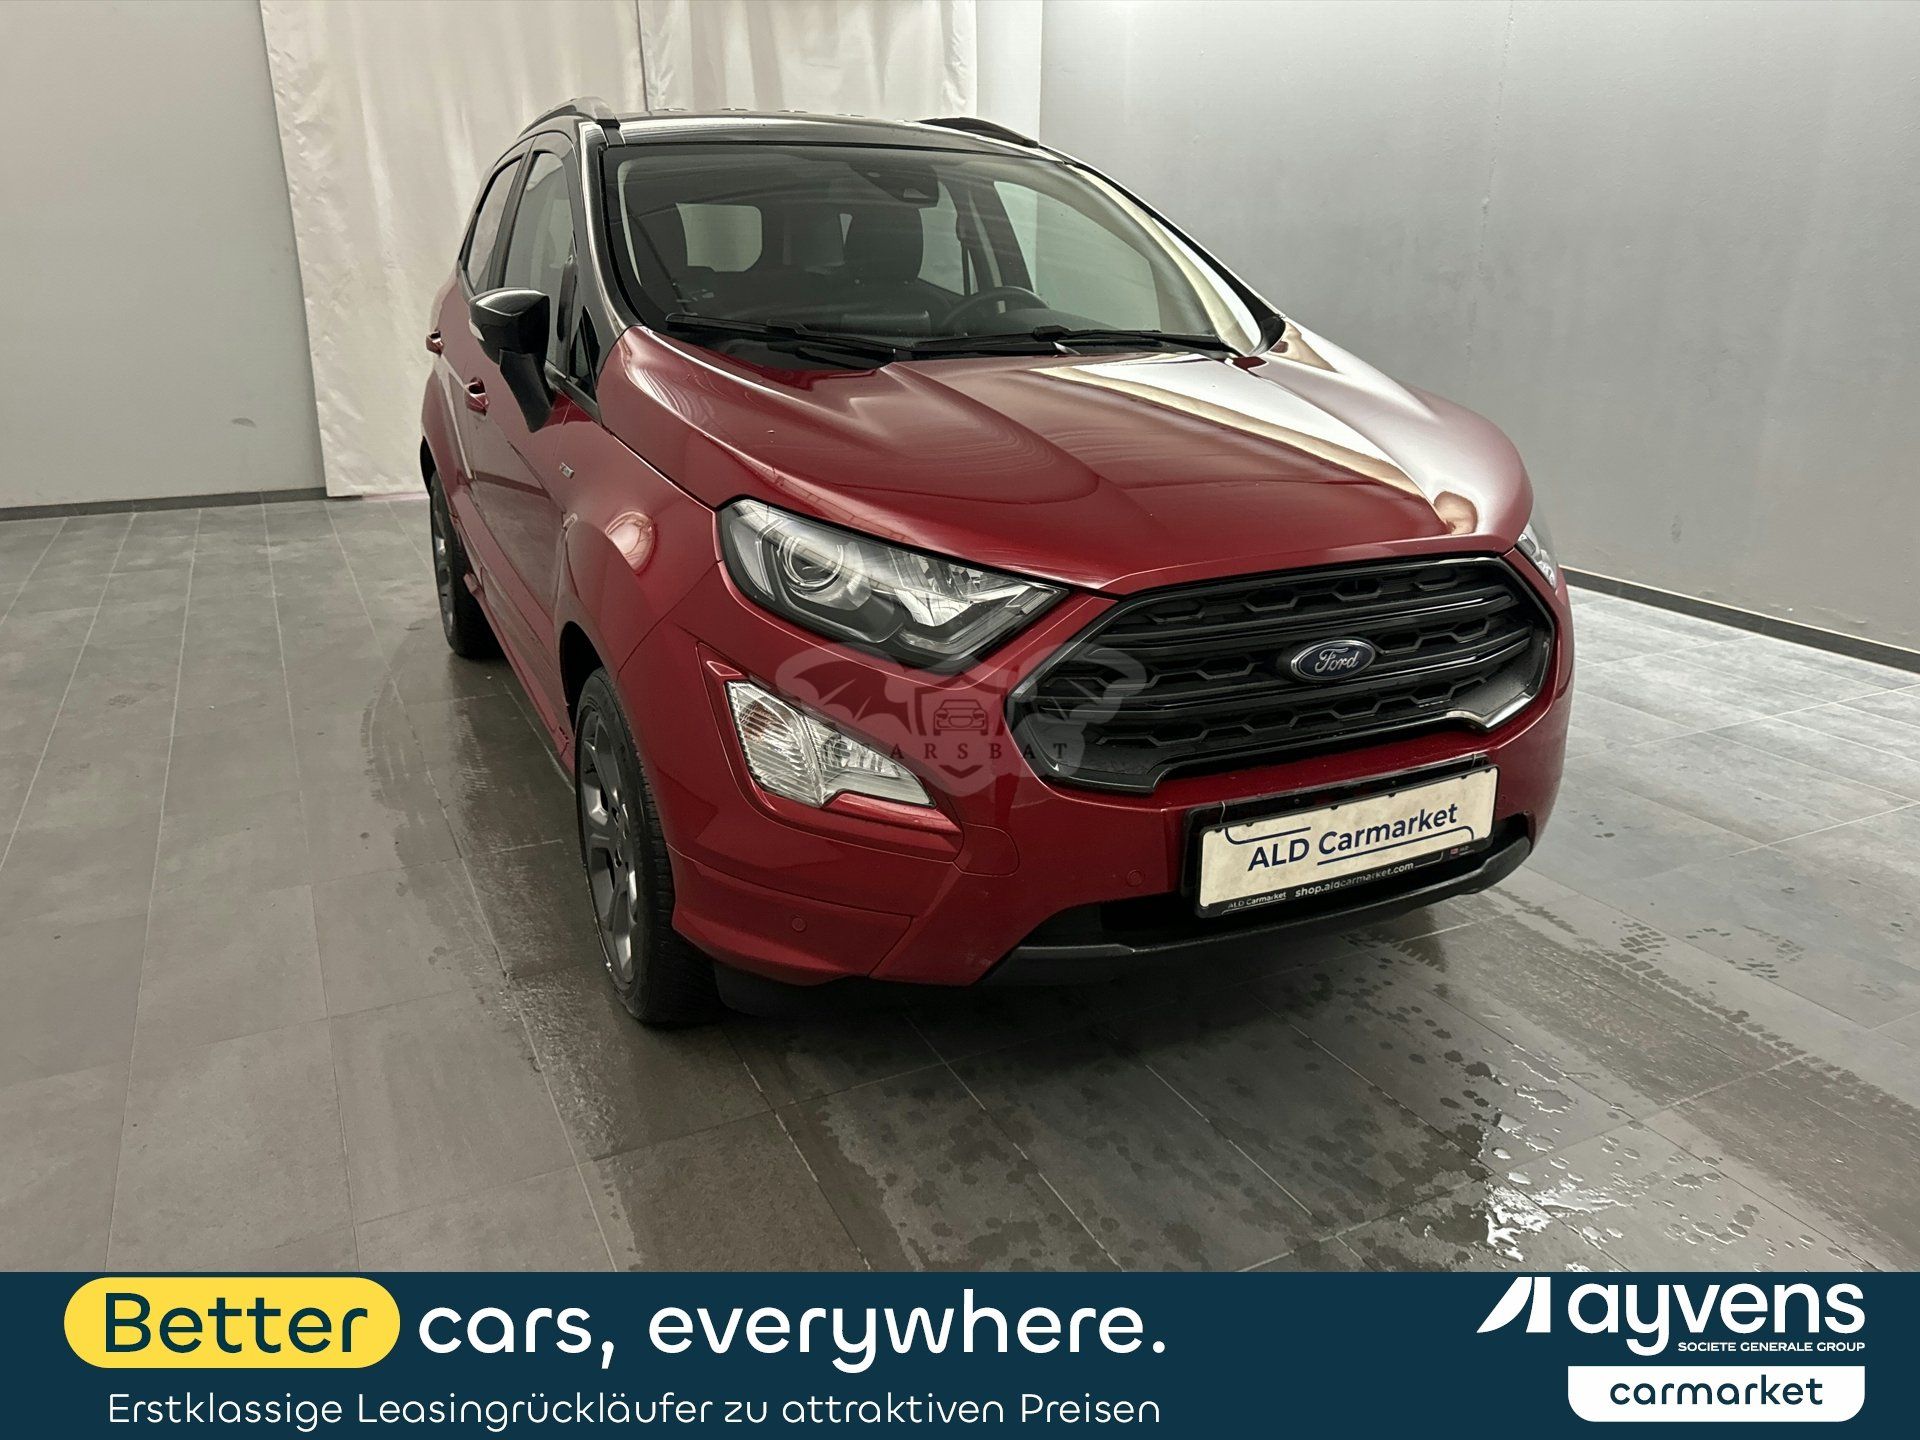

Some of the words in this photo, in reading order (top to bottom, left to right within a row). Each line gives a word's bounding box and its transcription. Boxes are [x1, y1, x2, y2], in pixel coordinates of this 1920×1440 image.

[1315, 647, 1361, 673] Ford
[1248, 838, 1309, 871] ALD
[1318, 804, 1458, 855] Carmarket
[1295, 862, 1414, 898] shop.aldcarmarket.com
[1228, 900, 1245, 910] ALD
[1246, 891, 1287, 906] Carmarket
